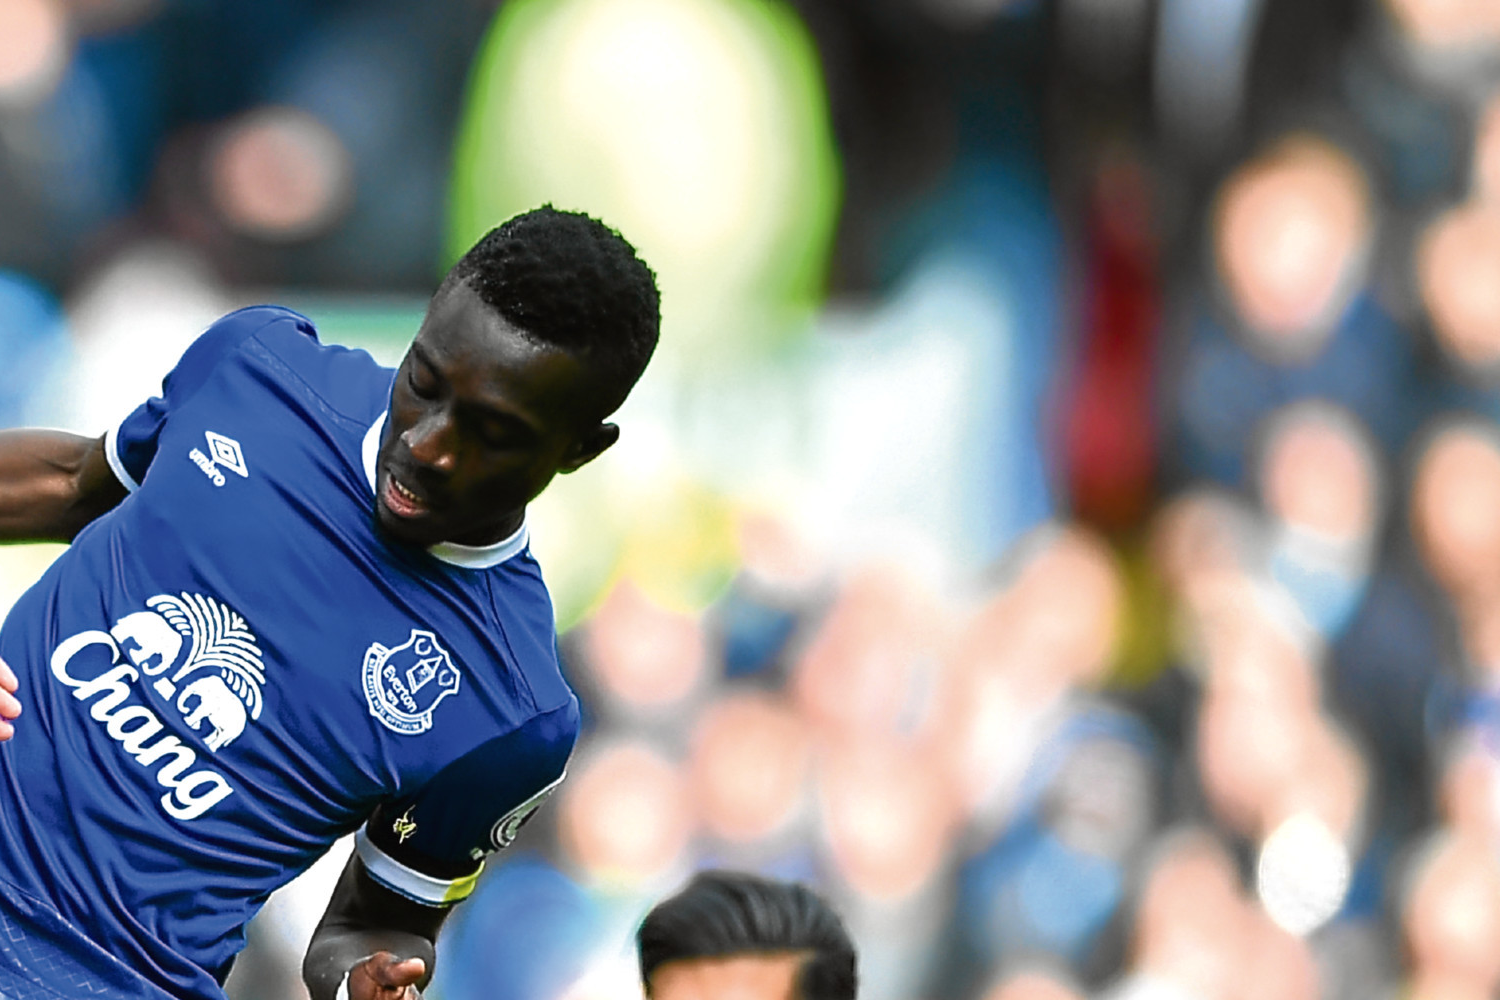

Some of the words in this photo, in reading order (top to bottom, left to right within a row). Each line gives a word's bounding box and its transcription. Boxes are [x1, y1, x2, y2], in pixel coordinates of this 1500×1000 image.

[188, 448, 226, 486] umbro
[383, 664, 417, 713] Everton
[51, 630, 233, 820] Chang
